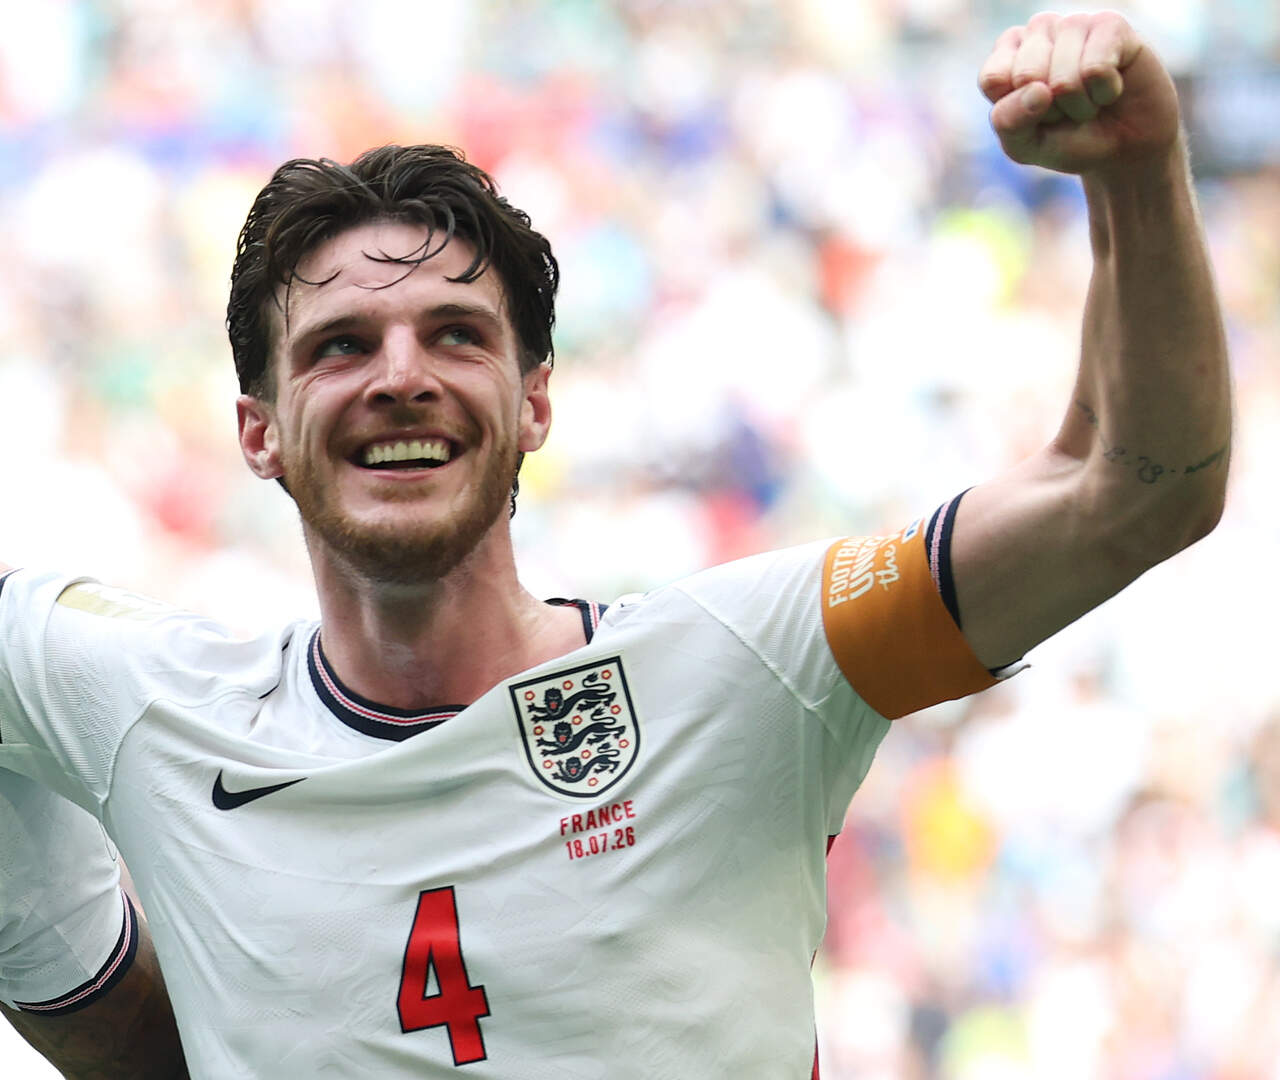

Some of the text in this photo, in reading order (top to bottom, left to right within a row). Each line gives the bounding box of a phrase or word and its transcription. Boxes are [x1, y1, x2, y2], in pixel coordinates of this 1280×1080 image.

[875, 544, 900, 591] the
[559, 800, 637, 837] FRANCE
[566, 826, 636, 860] 18.07.26
[397, 886, 490, 1066] 4
